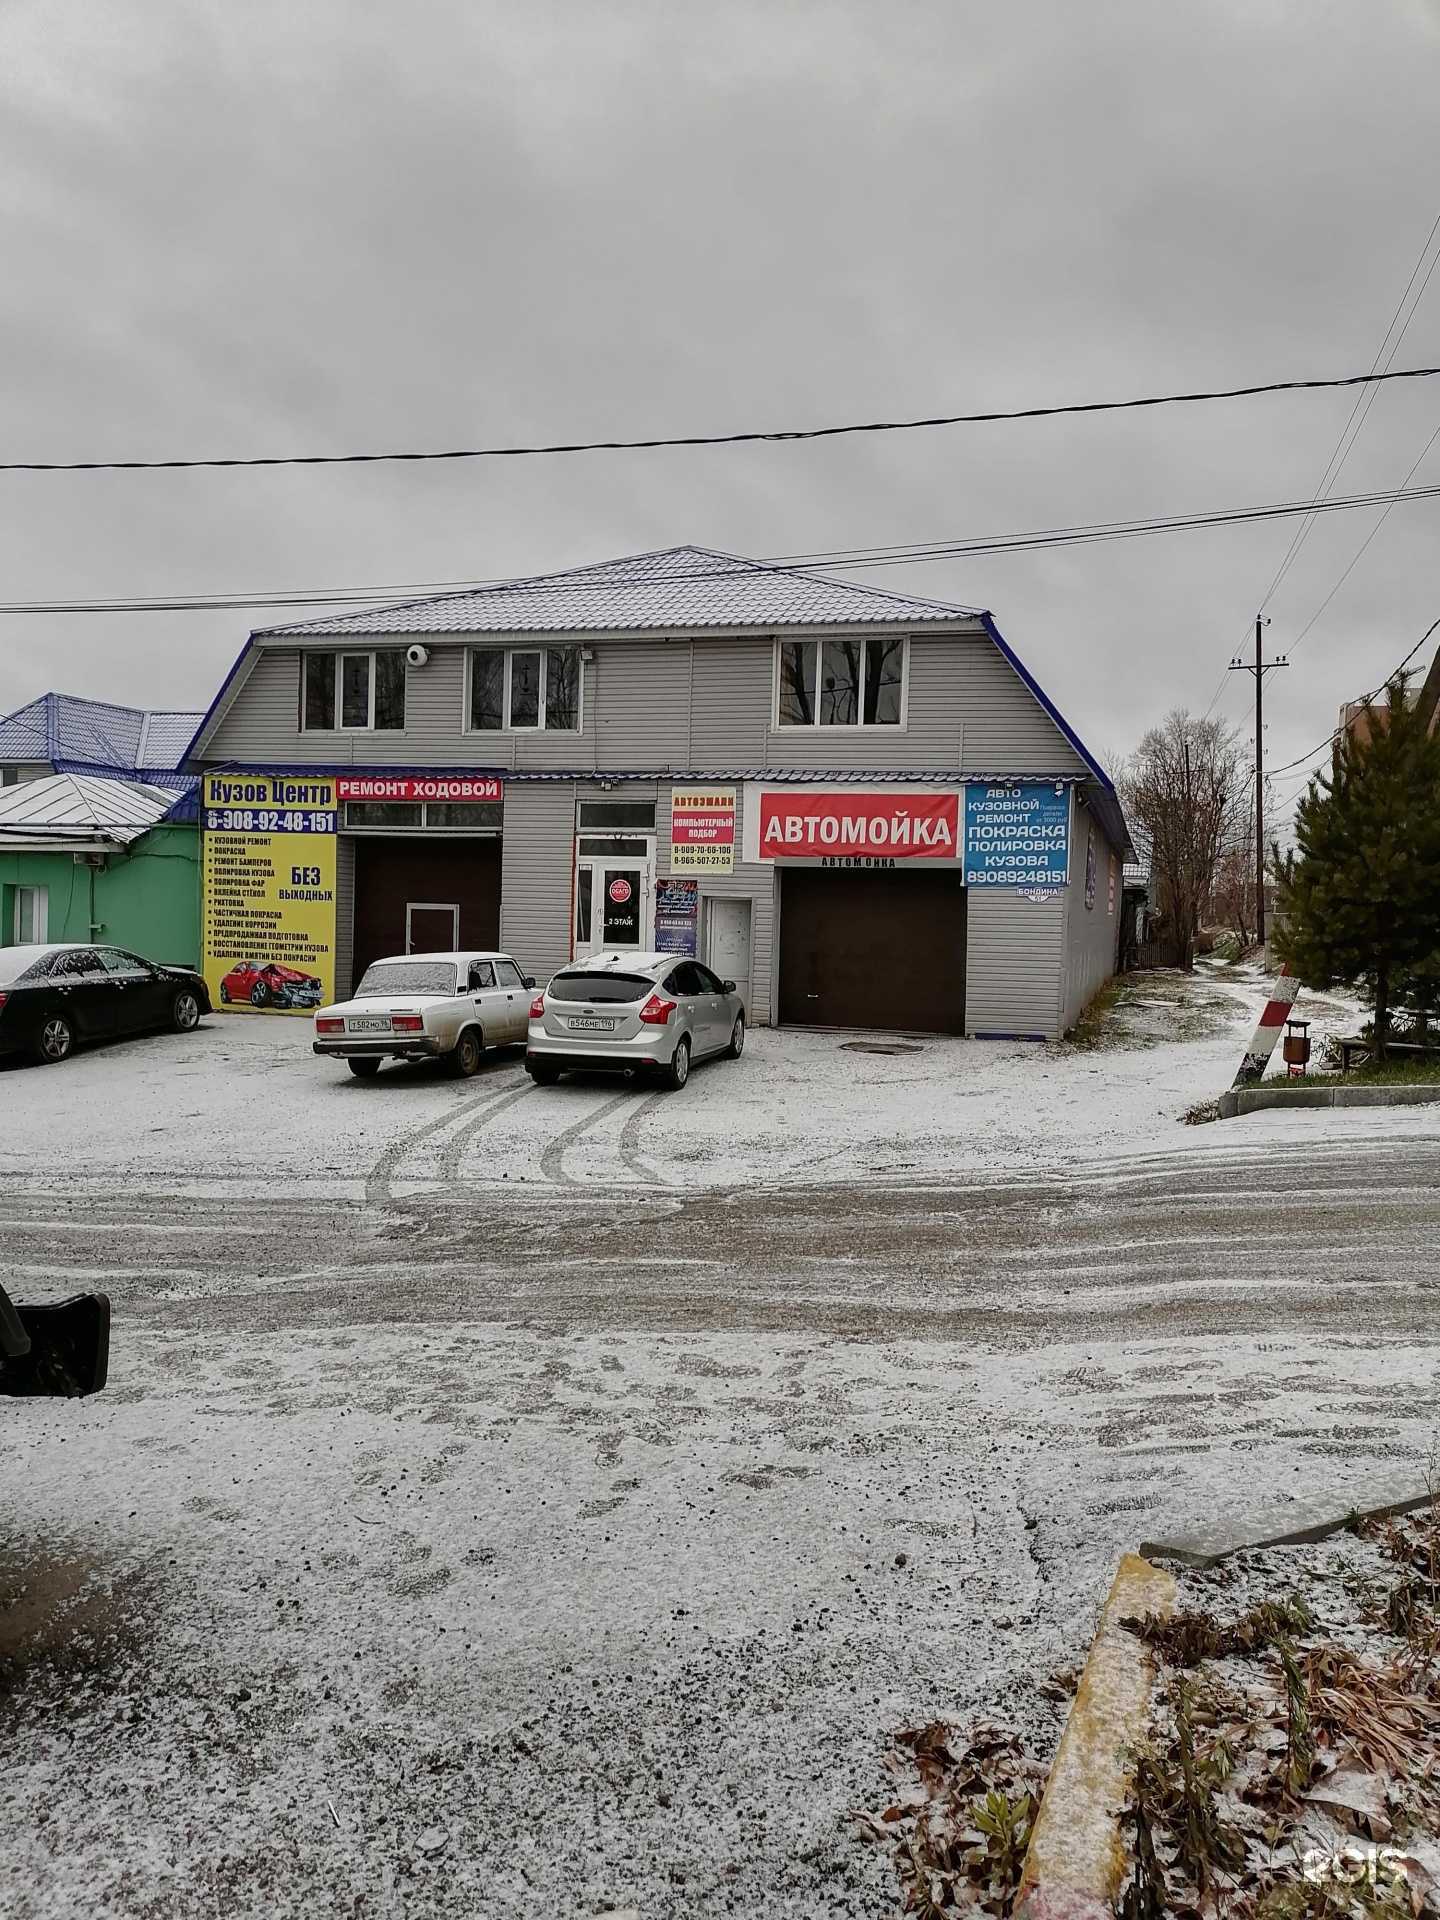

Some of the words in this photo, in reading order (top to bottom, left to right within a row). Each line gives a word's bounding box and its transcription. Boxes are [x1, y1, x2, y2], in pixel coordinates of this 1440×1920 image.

[210, 780, 267, 803] Кузов
[272, 781, 332, 806] Центр
[339, 781, 408, 796] РЕМОНТ
[412, 780, 498, 798] ХОДОВОЙ
[986, 788, 1021, 798] АВТО
[968, 798, 1040, 811] КУЗОВНОЙ
[976, 813, 1031, 824] РЕМОНТ
[764, 810, 953, 846] АВТОМОЙКА
[968, 825, 1066, 839] ПОКРАСКА
[688, 829, 718, 839] ПОДБОР
[214, 836, 246, 845] КУЗОВНОЙ
[247, 838, 272, 846] РЕМОНТ
[968, 840, 1067, 852] ПОЛИРОВКА
[214, 847, 246, 856] ПОКРАСКА
[214, 858, 238, 866] РЕМОНТ
[239, 859, 272, 867] БАМПЕРОВ
[985, 855, 1049, 867] КУЗОВА
[214, 868, 251, 877] ПОЛИРОВКА
[251, 869, 275, 878] КУЗОВА
[291, 867, 321, 886] БЕЗ
[967, 870, 1066, 883] 89089248151
[214, 878, 250, 887] ПОЛИРОВКА
[279, 889, 333, 902] ВЫХОДНЫХ
[213, 899, 245, 907] РИХТОВКА
[213, 909, 249, 918] ЧАСТИЧНАЯ
[250, 911, 283, 920] ПОКРАСКА
[213, 919, 244, 929] УДАЛЕНИЕ
[245, 921, 277, 930] КОРРОЗИИ
[268, 932, 309, 941] ПОДГОТОВКА
[213, 940, 268, 950] ВОССТАНОВЛЕНИЕ
[268, 943, 304, 952] ГЕОМЕТРИИ
[304, 944, 329, 953] КУЗОВА
[213, 950, 244, 960] УДАЛЕНИЕ
[244, 952, 270, 961] ВМЯТИН
[270, 954, 283, 962] БЕЗ
[283, 954, 317, 963] ПОКРАСКИ
